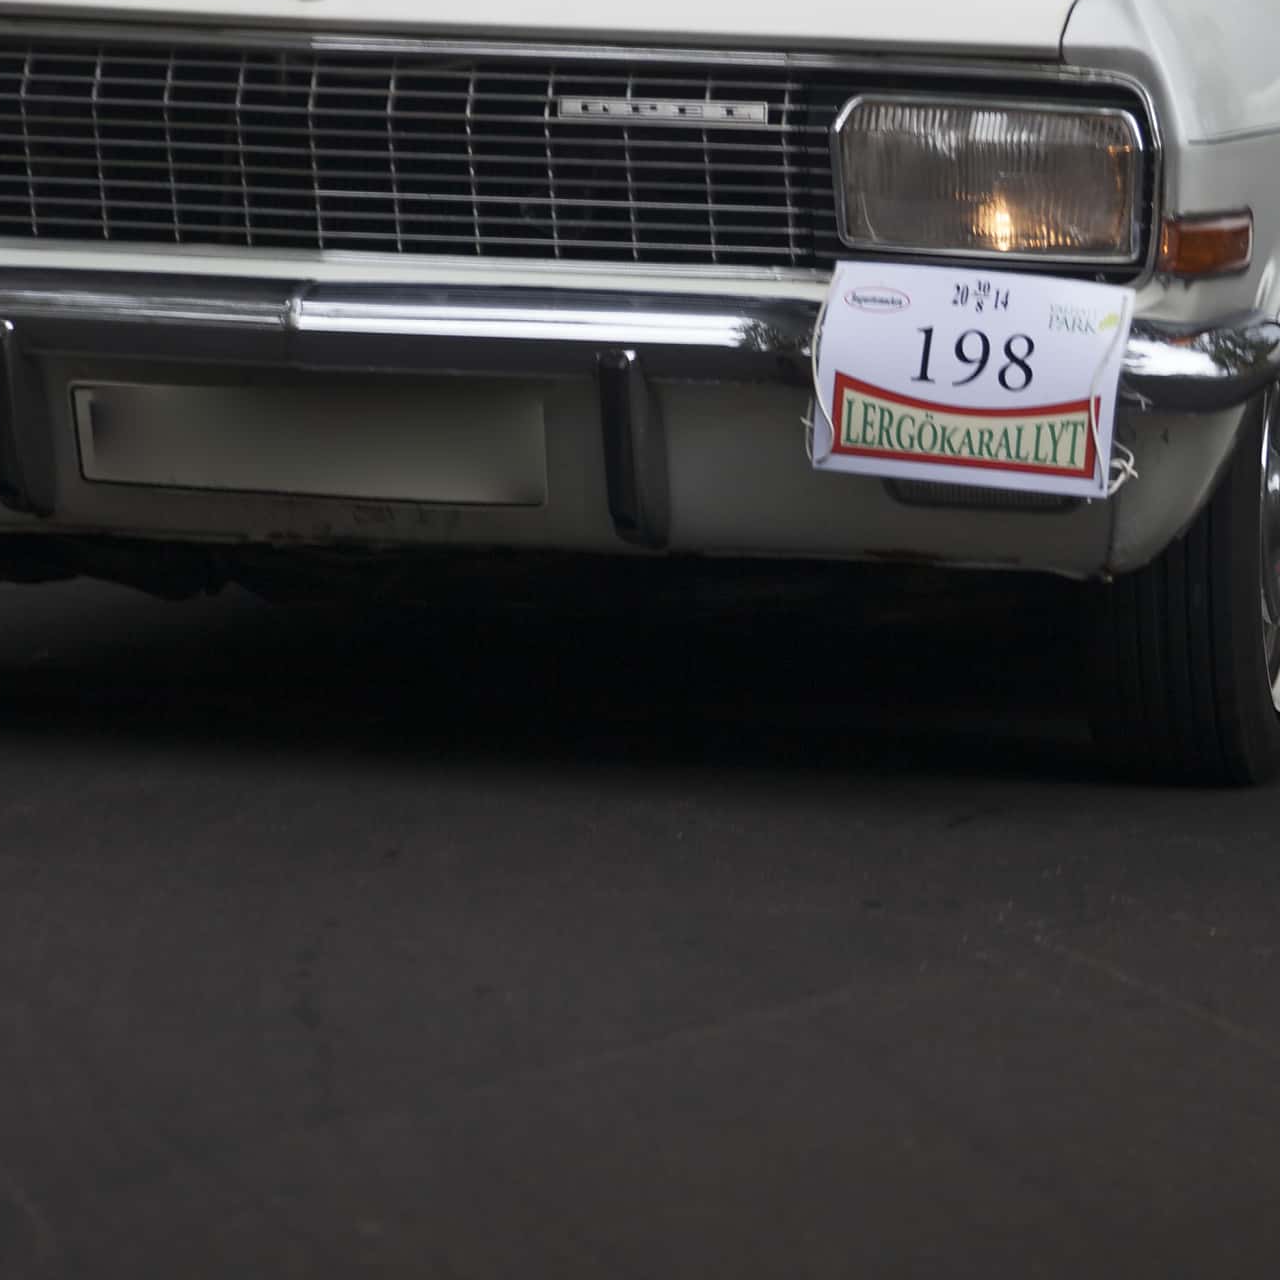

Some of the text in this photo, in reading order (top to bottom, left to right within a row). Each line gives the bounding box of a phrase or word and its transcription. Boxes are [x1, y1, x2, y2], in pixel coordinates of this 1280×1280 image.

[952, 284, 969, 307] 20
[994, 289, 1010, 310] 14
[1048, 314, 1097, 335] PARK
[910, 325, 1035, 392] 198
[844, 396, 1086, 467] LERGÖKARALLYT
